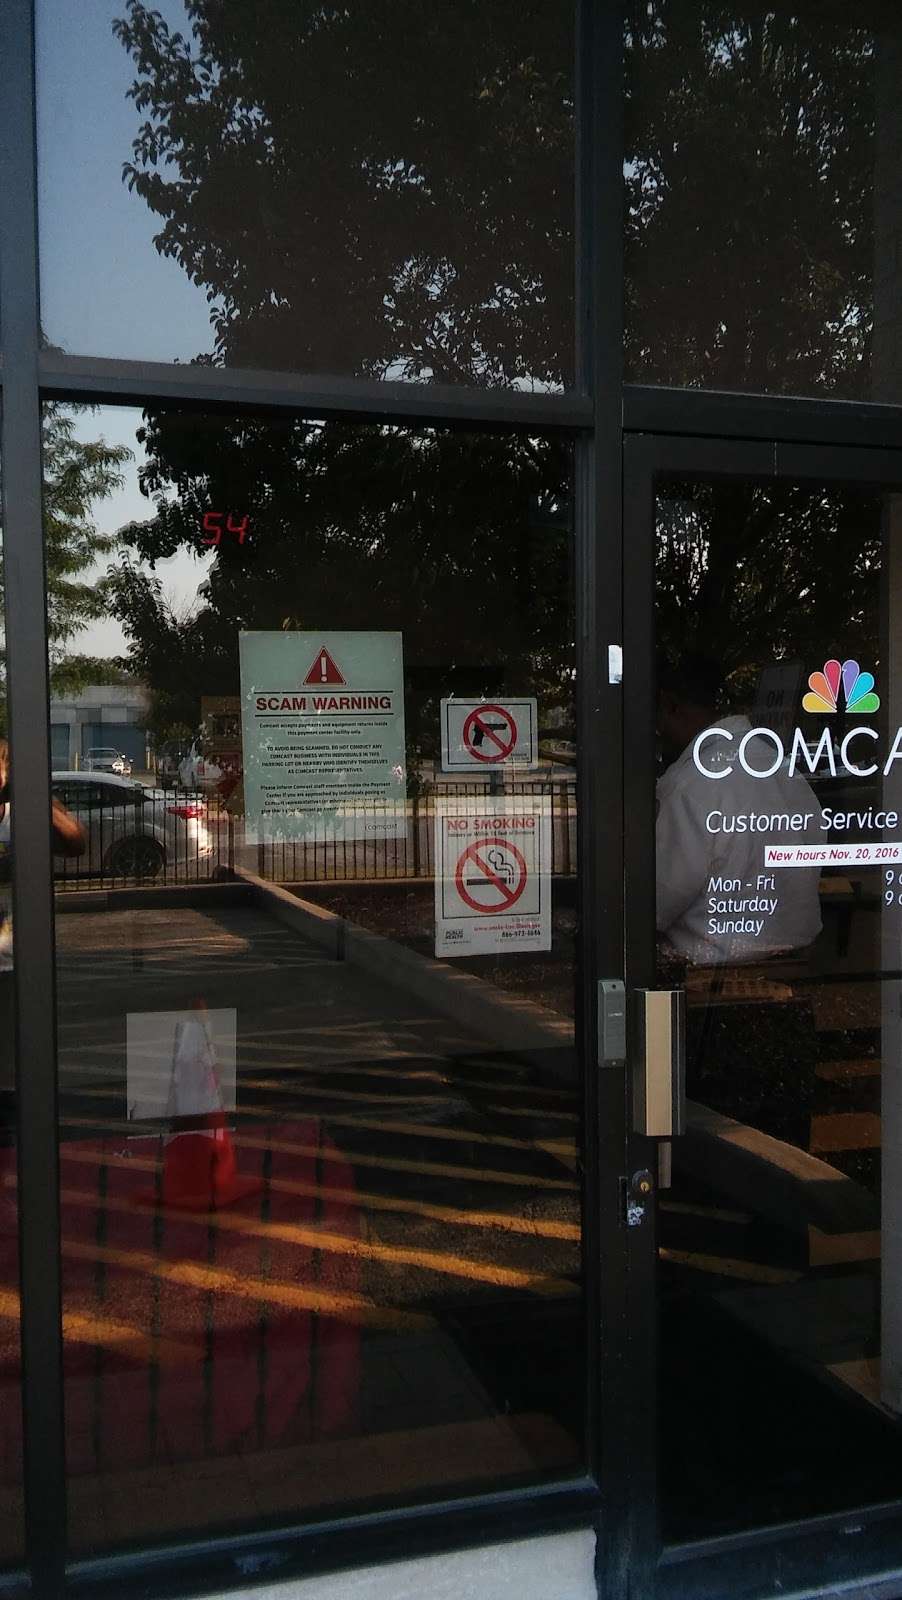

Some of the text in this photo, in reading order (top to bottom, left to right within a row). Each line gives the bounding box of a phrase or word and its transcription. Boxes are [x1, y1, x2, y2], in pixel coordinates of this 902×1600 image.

[200, 511, 249, 545] 54
[256, 696, 392, 711] SCAM WARNING
[448, 817, 536, 831] NO SMOKING
[706, 806, 898, 834] Customer Service
[768, 847, 899, 861] New hours Nov. 20, 2016
[707, 876, 741, 892] Mon
[756, 873, 775, 891] Fri
[885, 870, 894, 886] 9
[707, 895, 778, 915] Saturday
[885, 890, 894, 906] 9
[707, 916, 765, 936] Sunday
